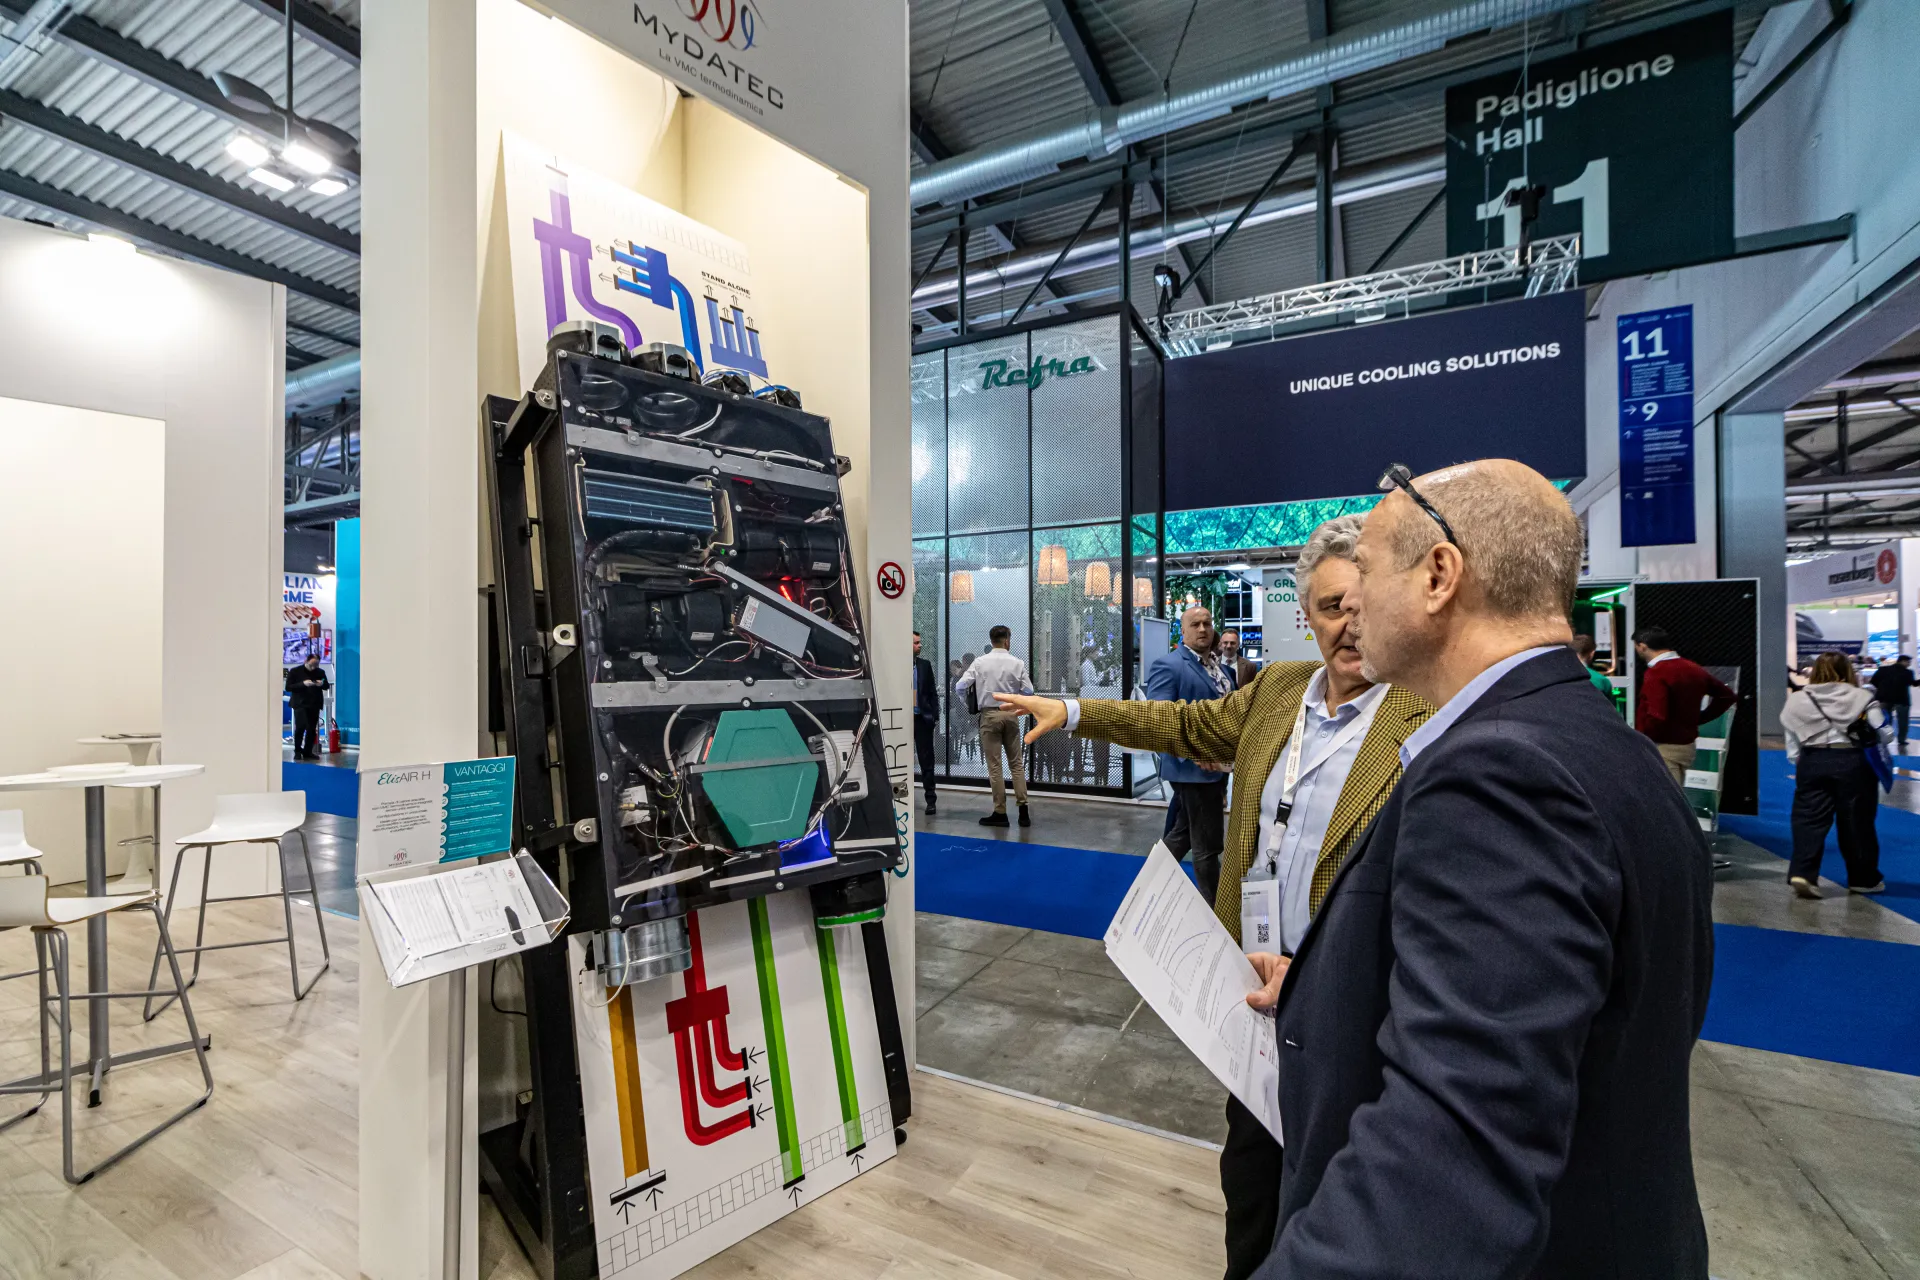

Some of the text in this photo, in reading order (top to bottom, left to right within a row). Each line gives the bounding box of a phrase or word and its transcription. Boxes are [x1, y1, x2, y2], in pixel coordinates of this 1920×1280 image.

[633, 2, 784, 110] MYDATEC
[659, 48, 764, 116] La VMC termodinamica
[1476, 54, 1675, 124] Padiglione
[1476, 116, 1543, 156] Hall
[1476, 157, 1609, 266] 11
[701, 271, 726, 285] STAND
[727, 282, 751, 295] ALONE
[1621, 327, 1669, 361] 11
[979, 355, 1096, 390] Refra
[1290, 342, 1560, 395] UNIQUE COOLING SOLUTIONS
[1642, 402, 1659, 421] 9
[1267, 593, 1298, 602] COOL
[1274, 579, 1297, 588] GRE
[377, 770, 431, 785] ElisAIR H
[454, 763, 505, 776] VANTAGGI
